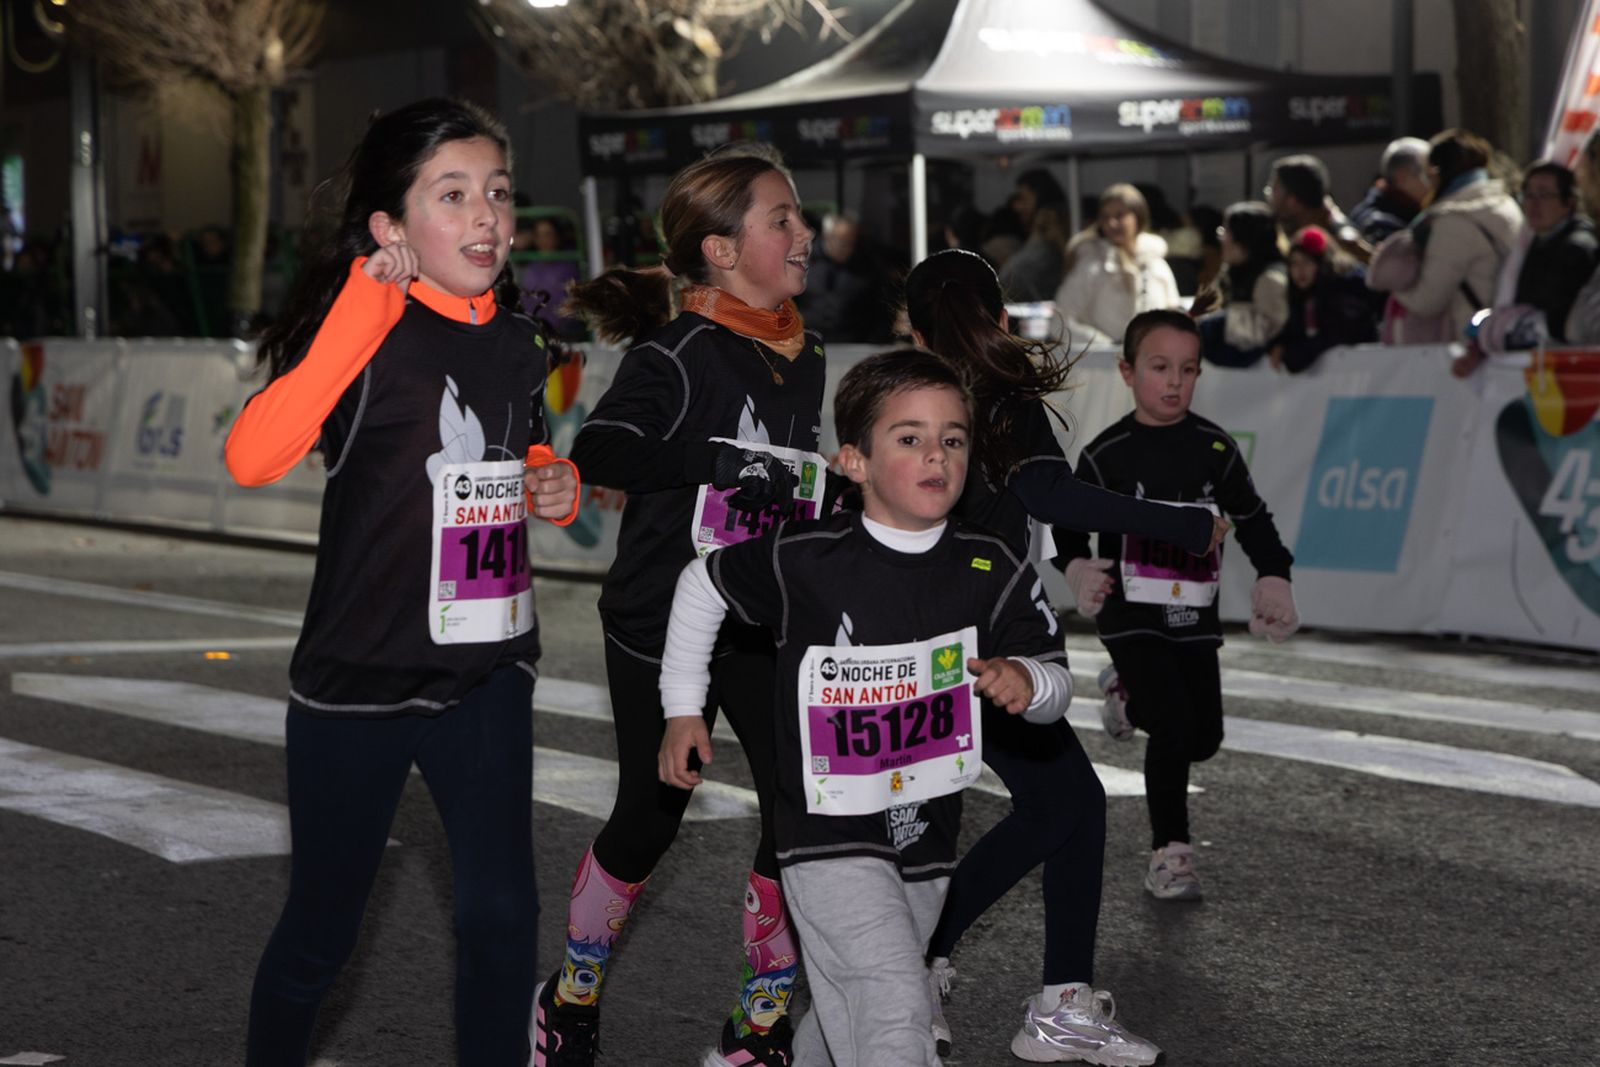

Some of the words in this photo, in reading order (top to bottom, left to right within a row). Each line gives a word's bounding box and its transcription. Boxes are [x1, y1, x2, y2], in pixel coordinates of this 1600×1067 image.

[455, 480, 471, 494] 43
[475, 481, 519, 500] NOCHE
[1317, 458, 1408, 510] alsa
[455, 503, 489, 525] SAN
[820, 661, 838, 676] 43
[841, 665, 895, 682] NOCHE
[897, 661, 917, 678] DE
[821, 687, 855, 705] SAN
[858, 679, 918, 704] ANTÓN
[827, 693, 954, 757] 15128
[890, 807, 918, 828] SAN
[893, 818, 930, 847] ANTÓN
